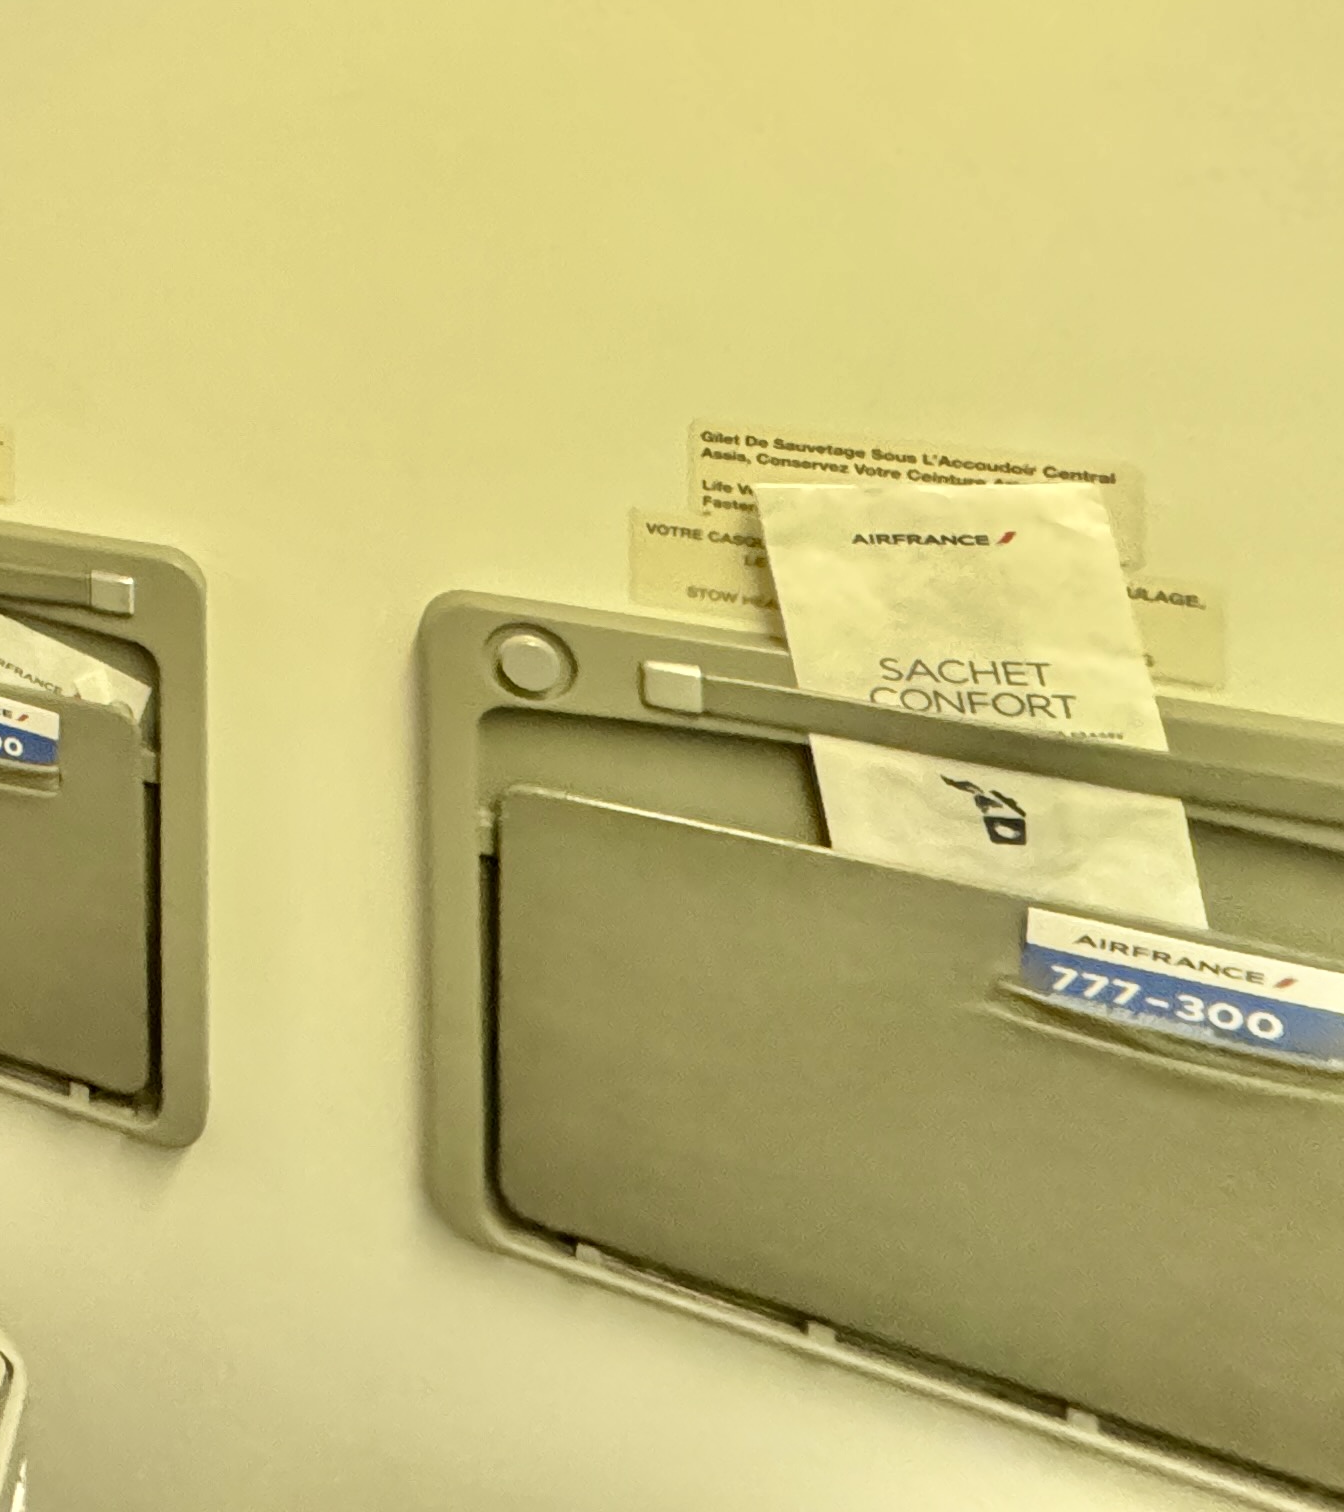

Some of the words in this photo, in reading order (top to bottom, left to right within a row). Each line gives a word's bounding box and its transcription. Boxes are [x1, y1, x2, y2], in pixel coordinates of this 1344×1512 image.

[700, 430, 740, 446] Gilet
[744, 434, 769, 449] De
[773, 438, 866, 461] Sauvetage
[871, 448, 917, 464] Sous
[922, 453, 1037, 477] L'Accoudoir
[1042, 465, 1116, 485] Central
[701, 447, 752, 465] Assis,
[756, 453, 849, 474] Conservez
[854, 463, 901, 480] Votre
[701, 479, 733, 495] Life
[646, 522, 703, 541] VOTRE
[852, 533, 990, 547] AIRFRANCE
[686, 586, 738, 604] STOW
[879, 657, 1053, 687] SACHET
[870, 686, 1077, 720] CONFORT
[1073, 933, 1266, 986] AIRFRANCE
[1049, 965, 1285, 1042] 777-300
